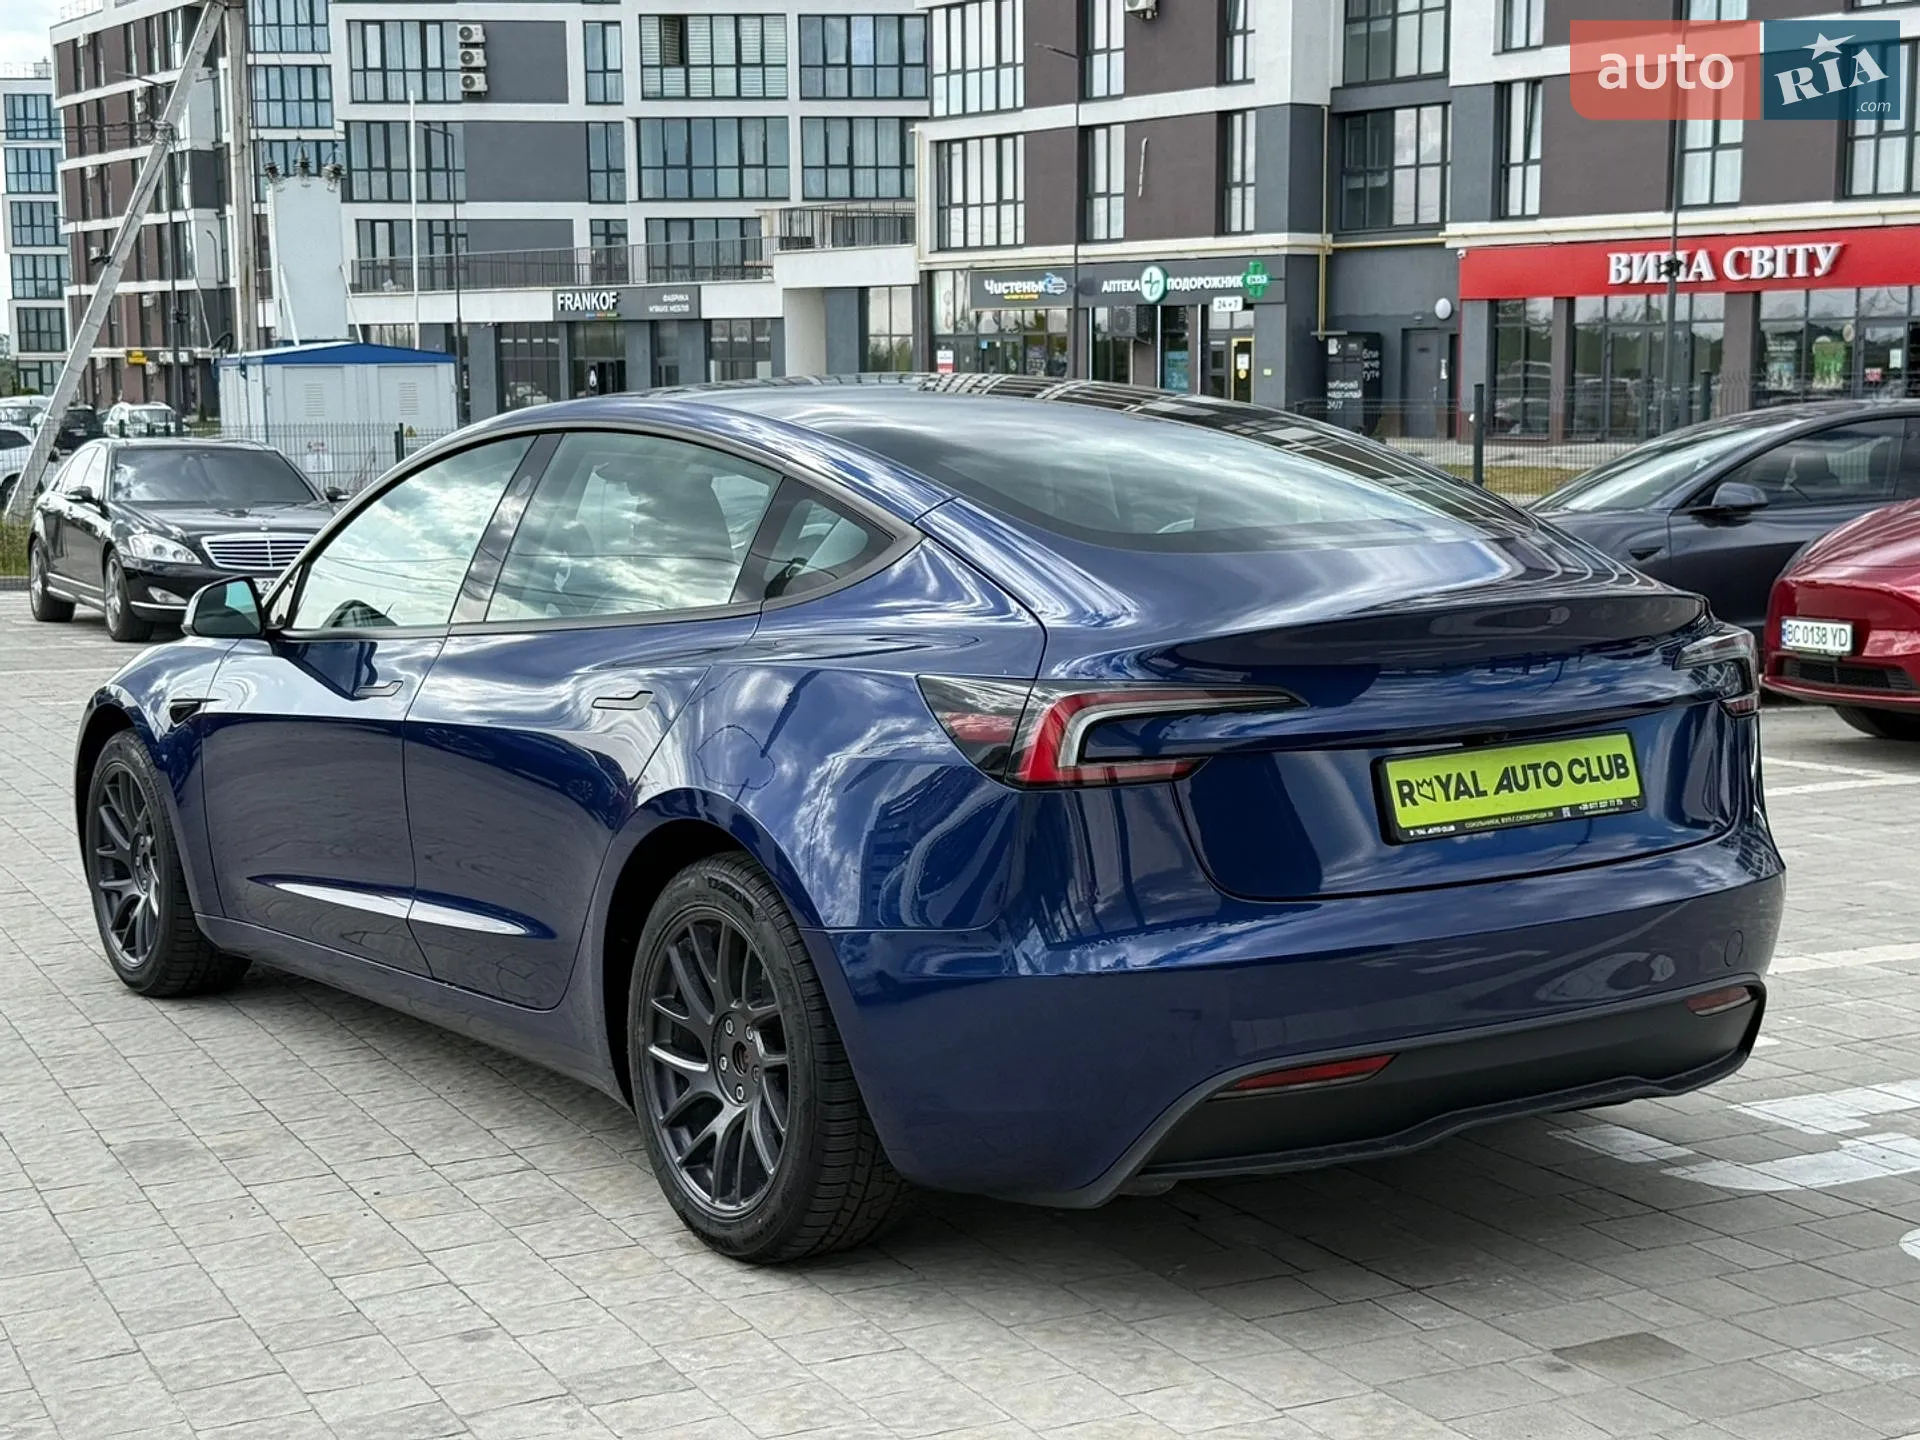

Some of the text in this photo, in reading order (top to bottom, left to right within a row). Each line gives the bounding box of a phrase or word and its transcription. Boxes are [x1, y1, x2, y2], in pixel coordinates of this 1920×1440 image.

[1723, 242, 1844, 281] СВІТУ
[1101, 275, 1244, 293] АПТЕКА ПОДОРОЖНИК
[557, 290, 618, 312] FRANKOF
[1802, 625, 1828, 645] 0138
[1830, 627, 1849, 648] YD
[1494, 760, 1564, 796] AUTO
[1568, 753, 1630, 785] CLUB
